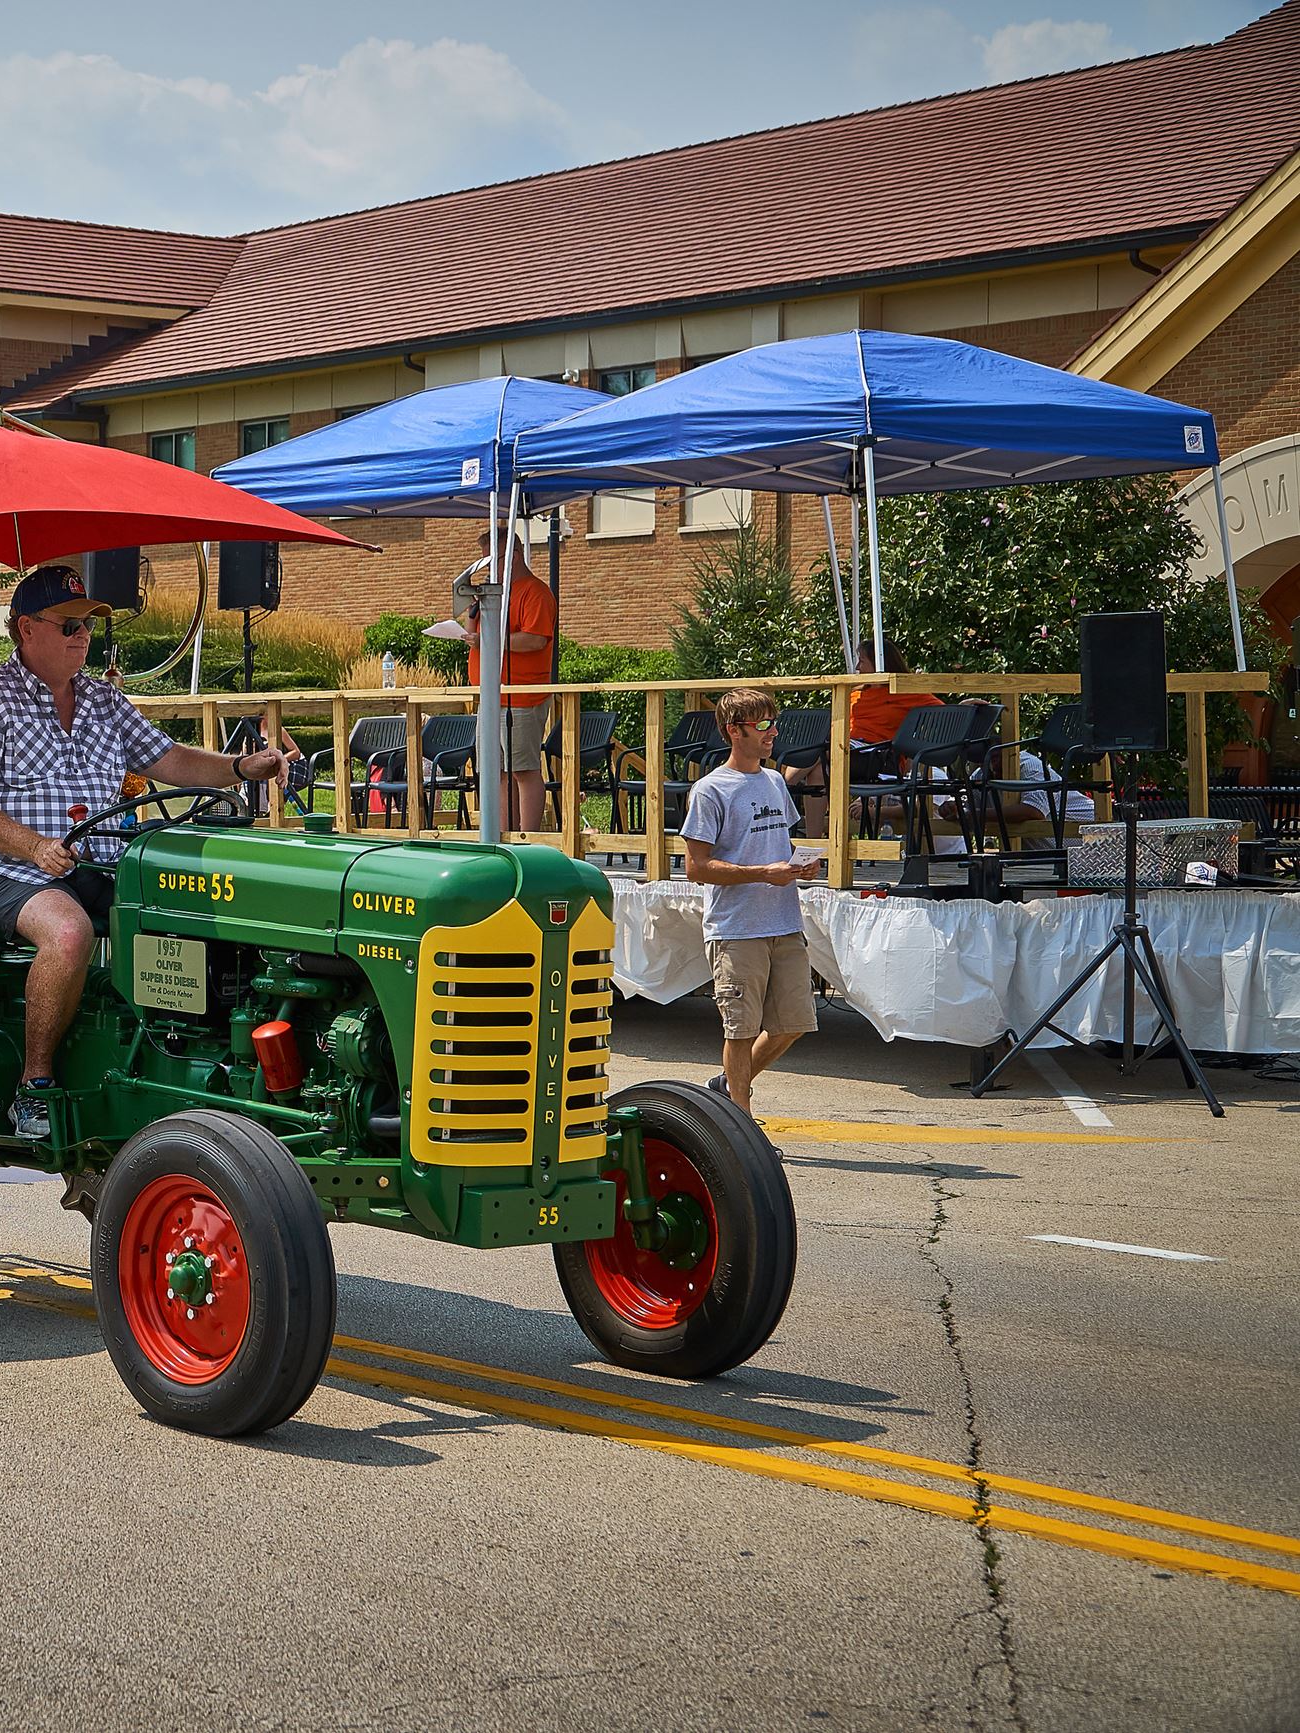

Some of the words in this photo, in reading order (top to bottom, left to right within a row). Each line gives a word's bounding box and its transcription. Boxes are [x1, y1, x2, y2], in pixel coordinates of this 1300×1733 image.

[159, 872, 206, 893] SUPER
[211, 873, 235, 902] 55
[353, 892, 415, 916] OLIVER
[157, 939, 183, 957] 1957
[358, 943, 402, 961] DIESEL
[156, 959, 183, 972] OLIVER
[140, 971, 163, 983] SUPER
[164, 974, 173, 985] 55
[174, 975, 200, 989] DIESEL
[147, 985, 156, 993] Tim
[163, 987, 176, 996] Doris
[544, 970, 562, 1124] OLIVER
[538, 1206, 559, 1226] 55
